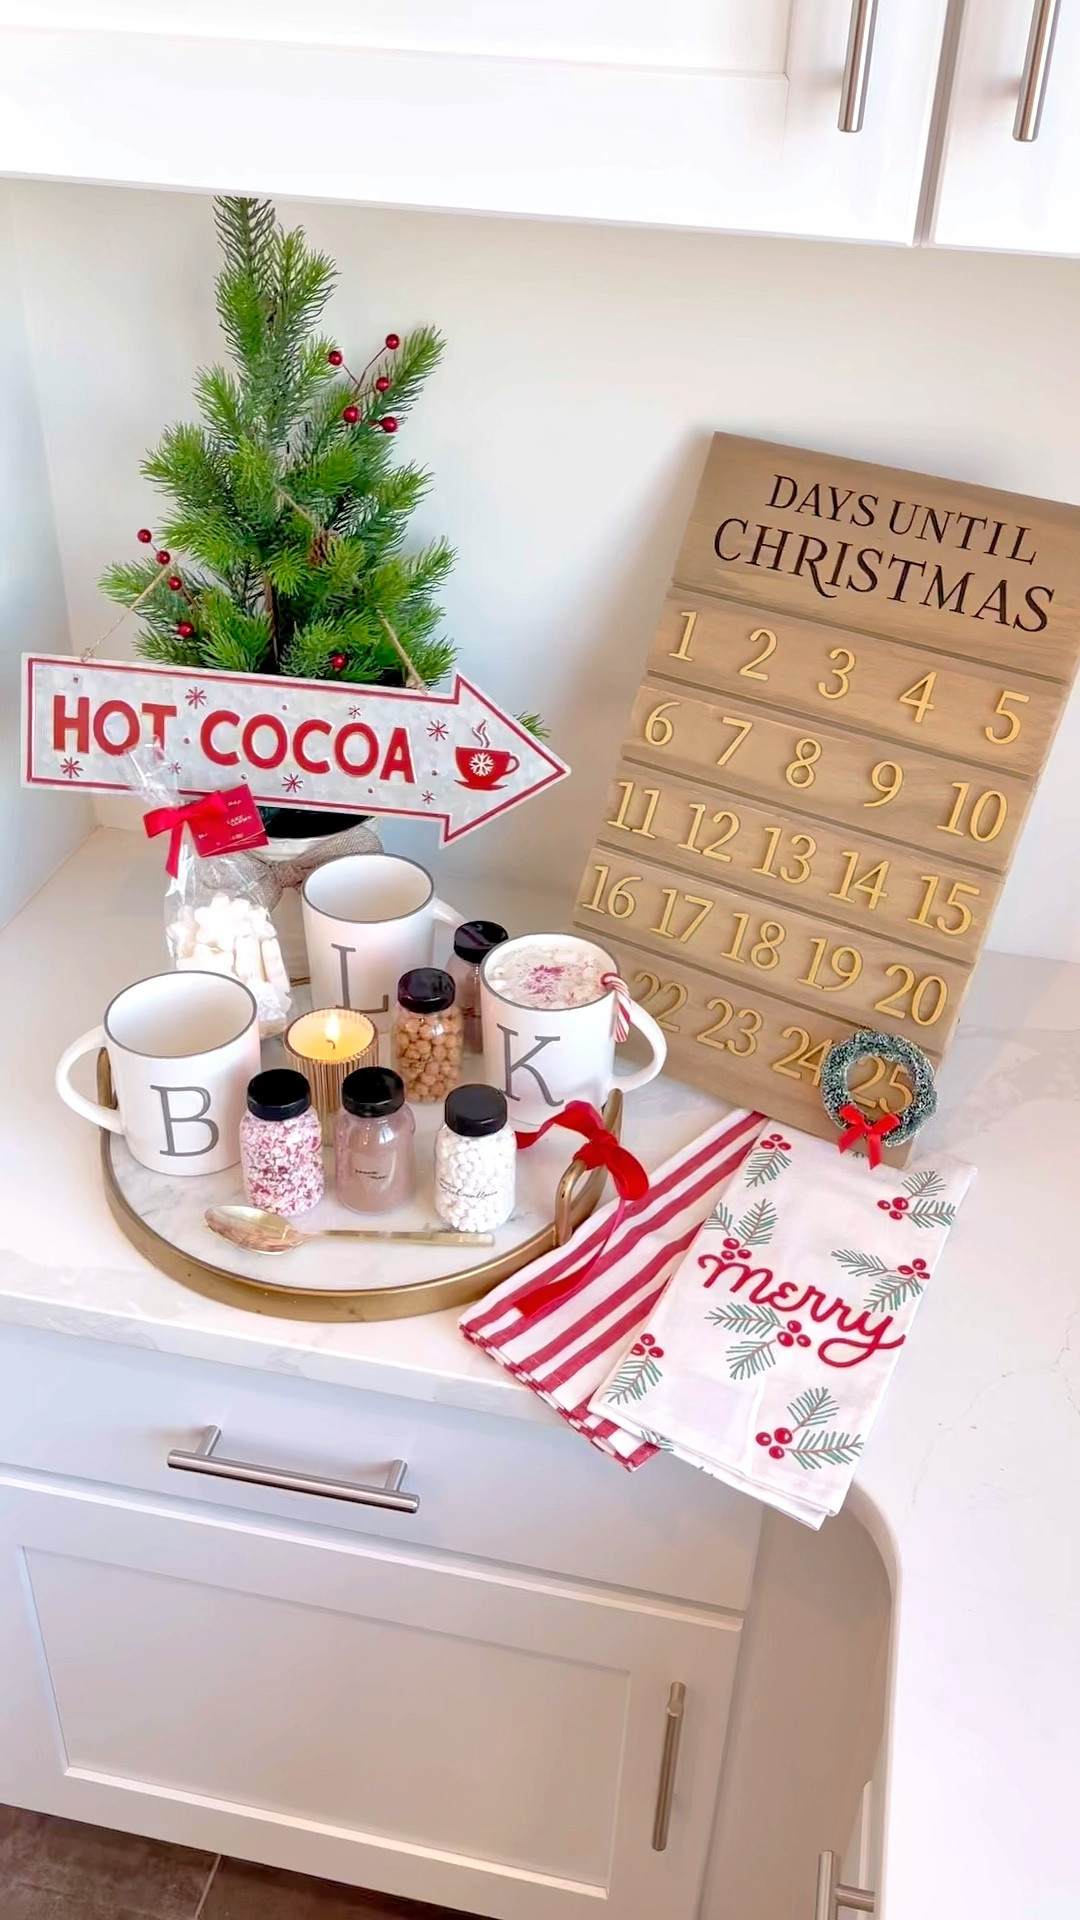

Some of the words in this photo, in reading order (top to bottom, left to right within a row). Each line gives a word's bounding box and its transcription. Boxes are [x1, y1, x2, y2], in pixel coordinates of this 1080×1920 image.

[713, 518, 1055, 633] CHRISTMAS
[764, 474, 880, 528] DAYS
[888, 500, 1038, 565] UNTIL
[668, 611, 699, 662] 1
[739, 628, 778, 681] 2
[818, 647, 856, 700] 3
[899, 671, 938, 724] 4
[984, 690, 1030, 745] 5
[53, 694, 178, 756] HOT
[200, 709, 416, 784] COCOA
[644, 701, 682, 746] 6
[717, 716, 753, 767] 7
[786, 738, 822, 789] 8
[864, 760, 904, 808] 9
[936, 781, 1008, 843] 10
[607, 780, 660, 840] 11
[677, 803, 740, 863] 12
[752, 826, 818, 885] 13
[828, 850, 891, 910] 14
[906, 874, 980, 937] 15
[330, 942, 389, 1014] L
[582, 864, 644, 920] 16
[650, 888, 714, 944] 17
[721, 911, 786, 971] 18
[797, 937, 864, 993] 19
[874, 964, 950, 1028] 20
[496, 1023, 565, 1107] K
[696, 998, 763, 1057] 23
[772, 1026, 832, 1088] 24
[850, 1056, 913, 1113] 25
[149, 1084, 219, 1157] B
[697, 1253, 906, 1368] merry
